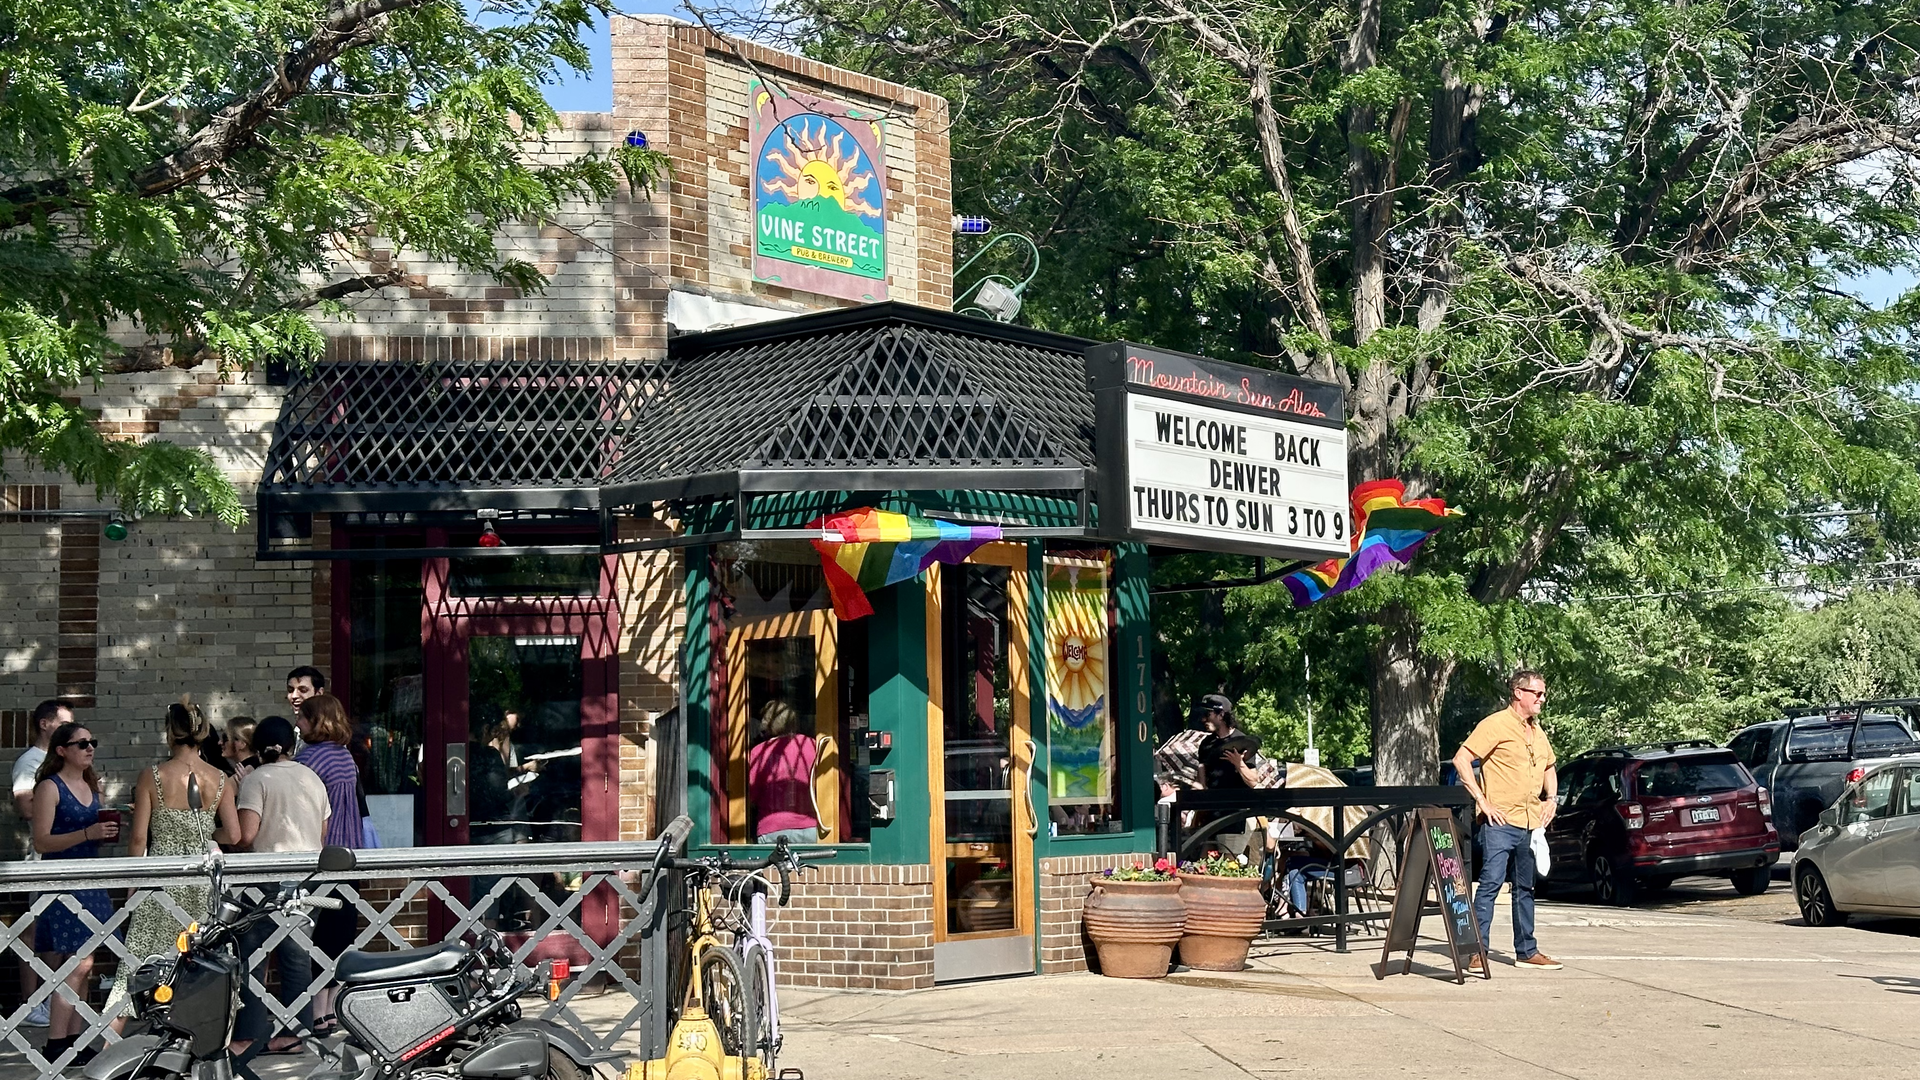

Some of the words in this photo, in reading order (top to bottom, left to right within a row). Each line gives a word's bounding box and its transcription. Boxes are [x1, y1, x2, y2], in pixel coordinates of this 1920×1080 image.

[761, 213, 805, 244] VINE
[811, 225, 880, 259] STREET
[796, 247, 810, 258] PUB
[811, 251, 816, 259] &
[818, 252, 849, 265] BREWERY
[1126, 356, 1231, 399] Mountain
[1237, 377, 1276, 410] Sun
[1278, 388, 1327, 419] Ales
[1155, 411, 1247, 456] WELCOME
[1274, 432, 1321, 467] BACK
[1210, 458, 1281, 497] DENVER
[1133, 486, 1200, 524] THURS
[1204, 494, 1229, 527] TO
[1236, 499, 1274, 533] SUN
[1288, 506, 1298, 535] 3
[1303, 508, 1326, 538] TO
[1333, 511, 1344, 540] 9
[1137, 635, 1147, 742] 1700
